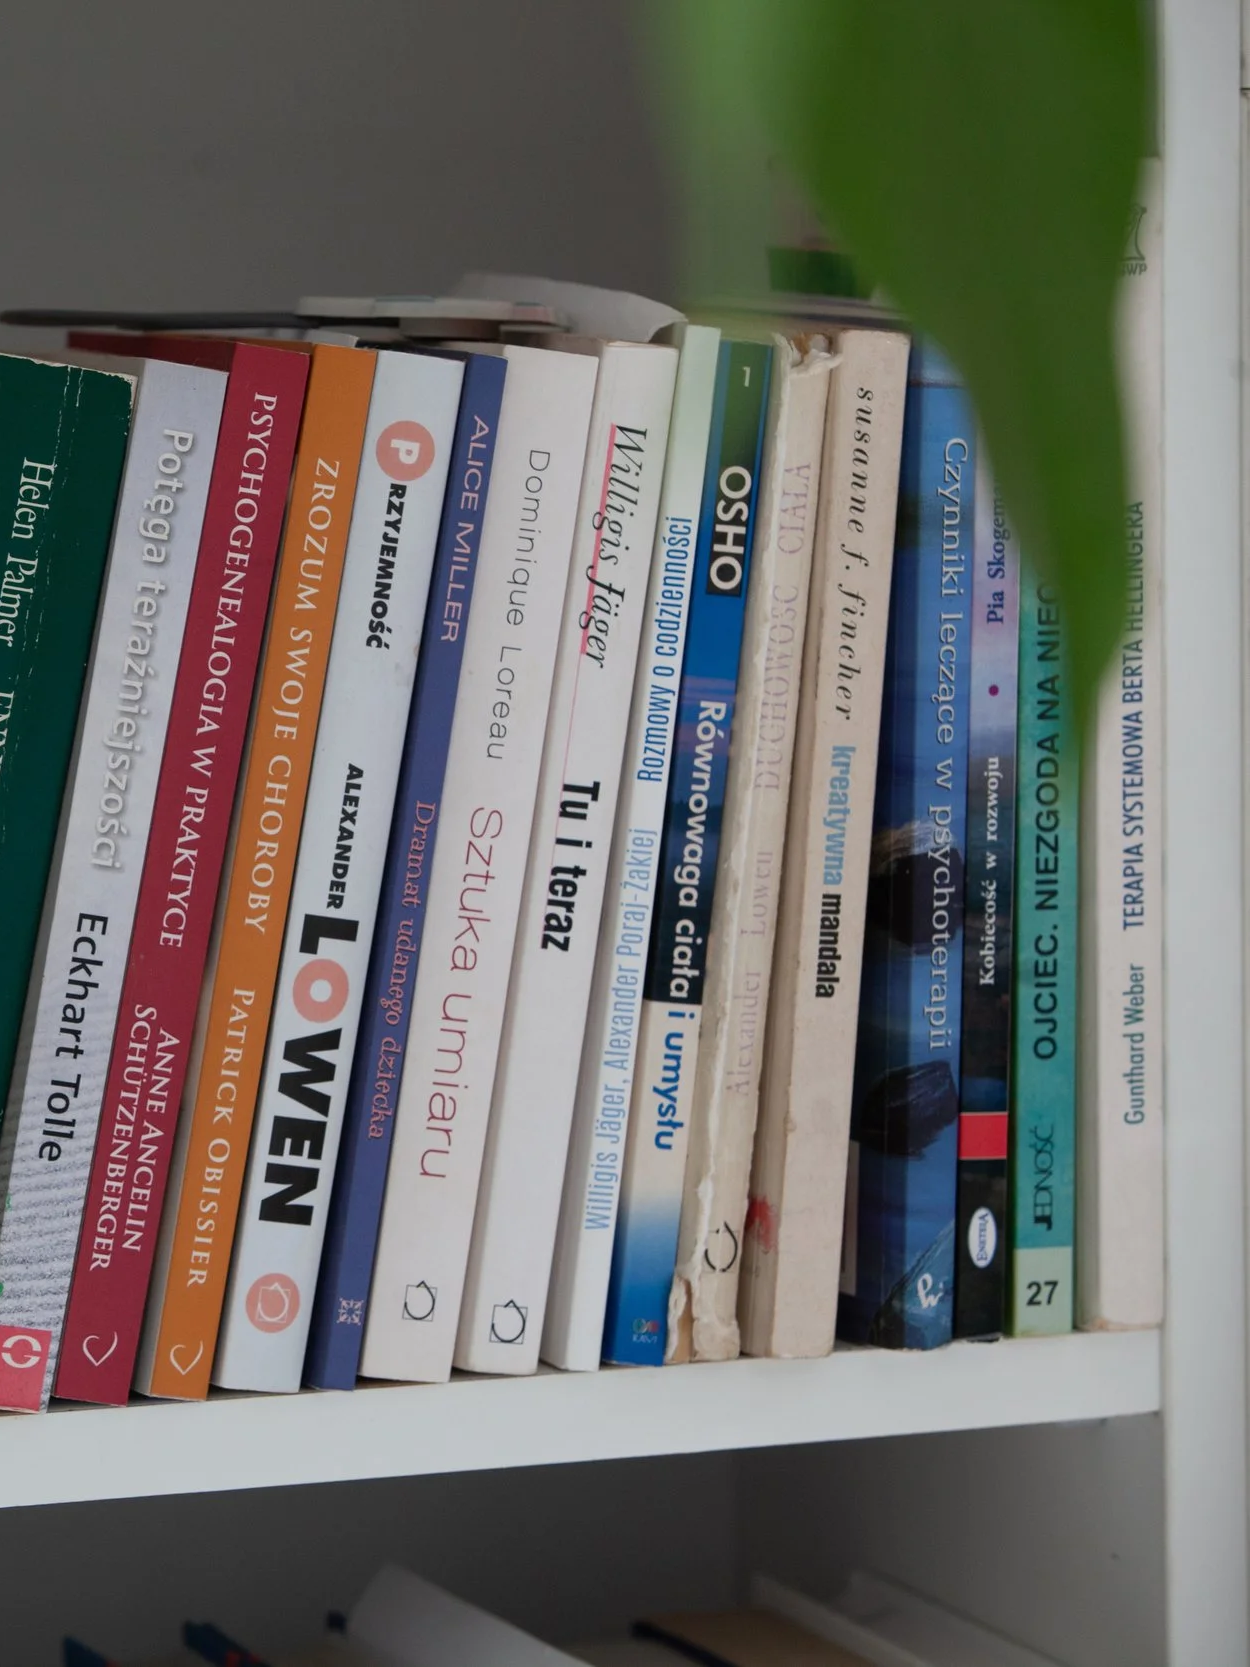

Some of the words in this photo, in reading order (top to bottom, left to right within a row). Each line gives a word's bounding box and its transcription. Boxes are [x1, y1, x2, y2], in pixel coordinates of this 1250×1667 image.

[743, 366, 751, 388] 1
[11, 455, 58, 540] Helen
[139, 428, 193, 567] Potęga
[461, 415, 491, 512] ALICE
[591, 425, 649, 568] Willigis
[848, 385, 876, 535] susanne
[937, 437, 969, 597] Czynniki
[193, 393, 278, 738] PSYCHOGENEALOGIA
[295, 458, 340, 612] ZROZUM
[439, 523, 476, 643] MILLER
[506, 448, 550, 628] Dominique
[709, 465, 752, 591] OSHO
[1124, 500, 1145, 635] HELLINGERA
[655, 515, 693, 660] codzienności
[986, 590, 1005, 624] Pia
[271, 624, 312, 742] SWOJE
[485, 646, 523, 762] Loreau
[653, 665, 674, 677] o
[837, 577, 869, 722] fincher
[932, 611, 963, 745] leczące
[1037, 672, 1061, 723] NA
[1121, 637, 1145, 703] BERTA
[90, 575, 167, 872] teraźniejszości
[187, 742, 218, 778] W
[637, 684, 675, 782] Rozmowy
[934, 755, 952, 792] w
[1121, 710, 1145, 836] SYSTEMOWA
[243, 754, 292, 935] CHOROBY
[325, 762, 365, 910] ALEXANDER
[400, 800, 437, 907] Dramat
[555, 837, 594, 850] i
[558, 780, 601, 823] Tu
[674, 700, 727, 908] Równowaga
[822, 744, 856, 888] kreatywna
[983, 755, 1001, 842] rozwoju
[1033, 733, 1061, 912] NIEZGODA
[158, 788, 209, 950] PRAKTYCE
[450, 806, 504, 973] Sztuka
[541, 860, 588, 953] teraz
[615, 828, 658, 958] Poraj-Żakiej
[986, 847, 998, 873] w
[1121, 840, 1145, 932] TERAPIA
[377, 916, 416, 1026] udanego
[668, 917, 703, 1000] ciała
[814, 892, 844, 1001] mandala
[924, 800, 958, 1052] psychoterapii
[979, 878, 998, 987] Kobiecość
[56, 912, 108, 1060] Eckhart
[604, 960, 638, 1072] Alexander
[667, 1010, 696, 1020] i
[1032, 922, 1059, 1062] OJCIEC.
[1123, 963, 1145, 1029] Weber
[146, 1027, 180, 1114] ANNE
[213, 988, 255, 1125] PATRICK
[258, 913, 361, 1227] LOWEN
[366, 1036, 400, 1140] dziecka
[419, 992, 474, 1181] umiaru
[595, 1076, 628, 1146] Jäger,
[654, 1030, 686, 1152] umysłu
[1123, 1033, 1145, 1126] Gunthard
[37, 1072, 82, 1163] Tolle
[90, 1003, 158, 1271] SCHÜTZENBERGER
[121, 1119, 165, 1253] ANCELIN
[186, 1137, 232, 1288] OBISSIER
[583, 1151, 620, 1232] Willigis
[1030, 1126, 1055, 1232] JEDNOŚĆ
[1025, 1281, 1059, 1307] 27
